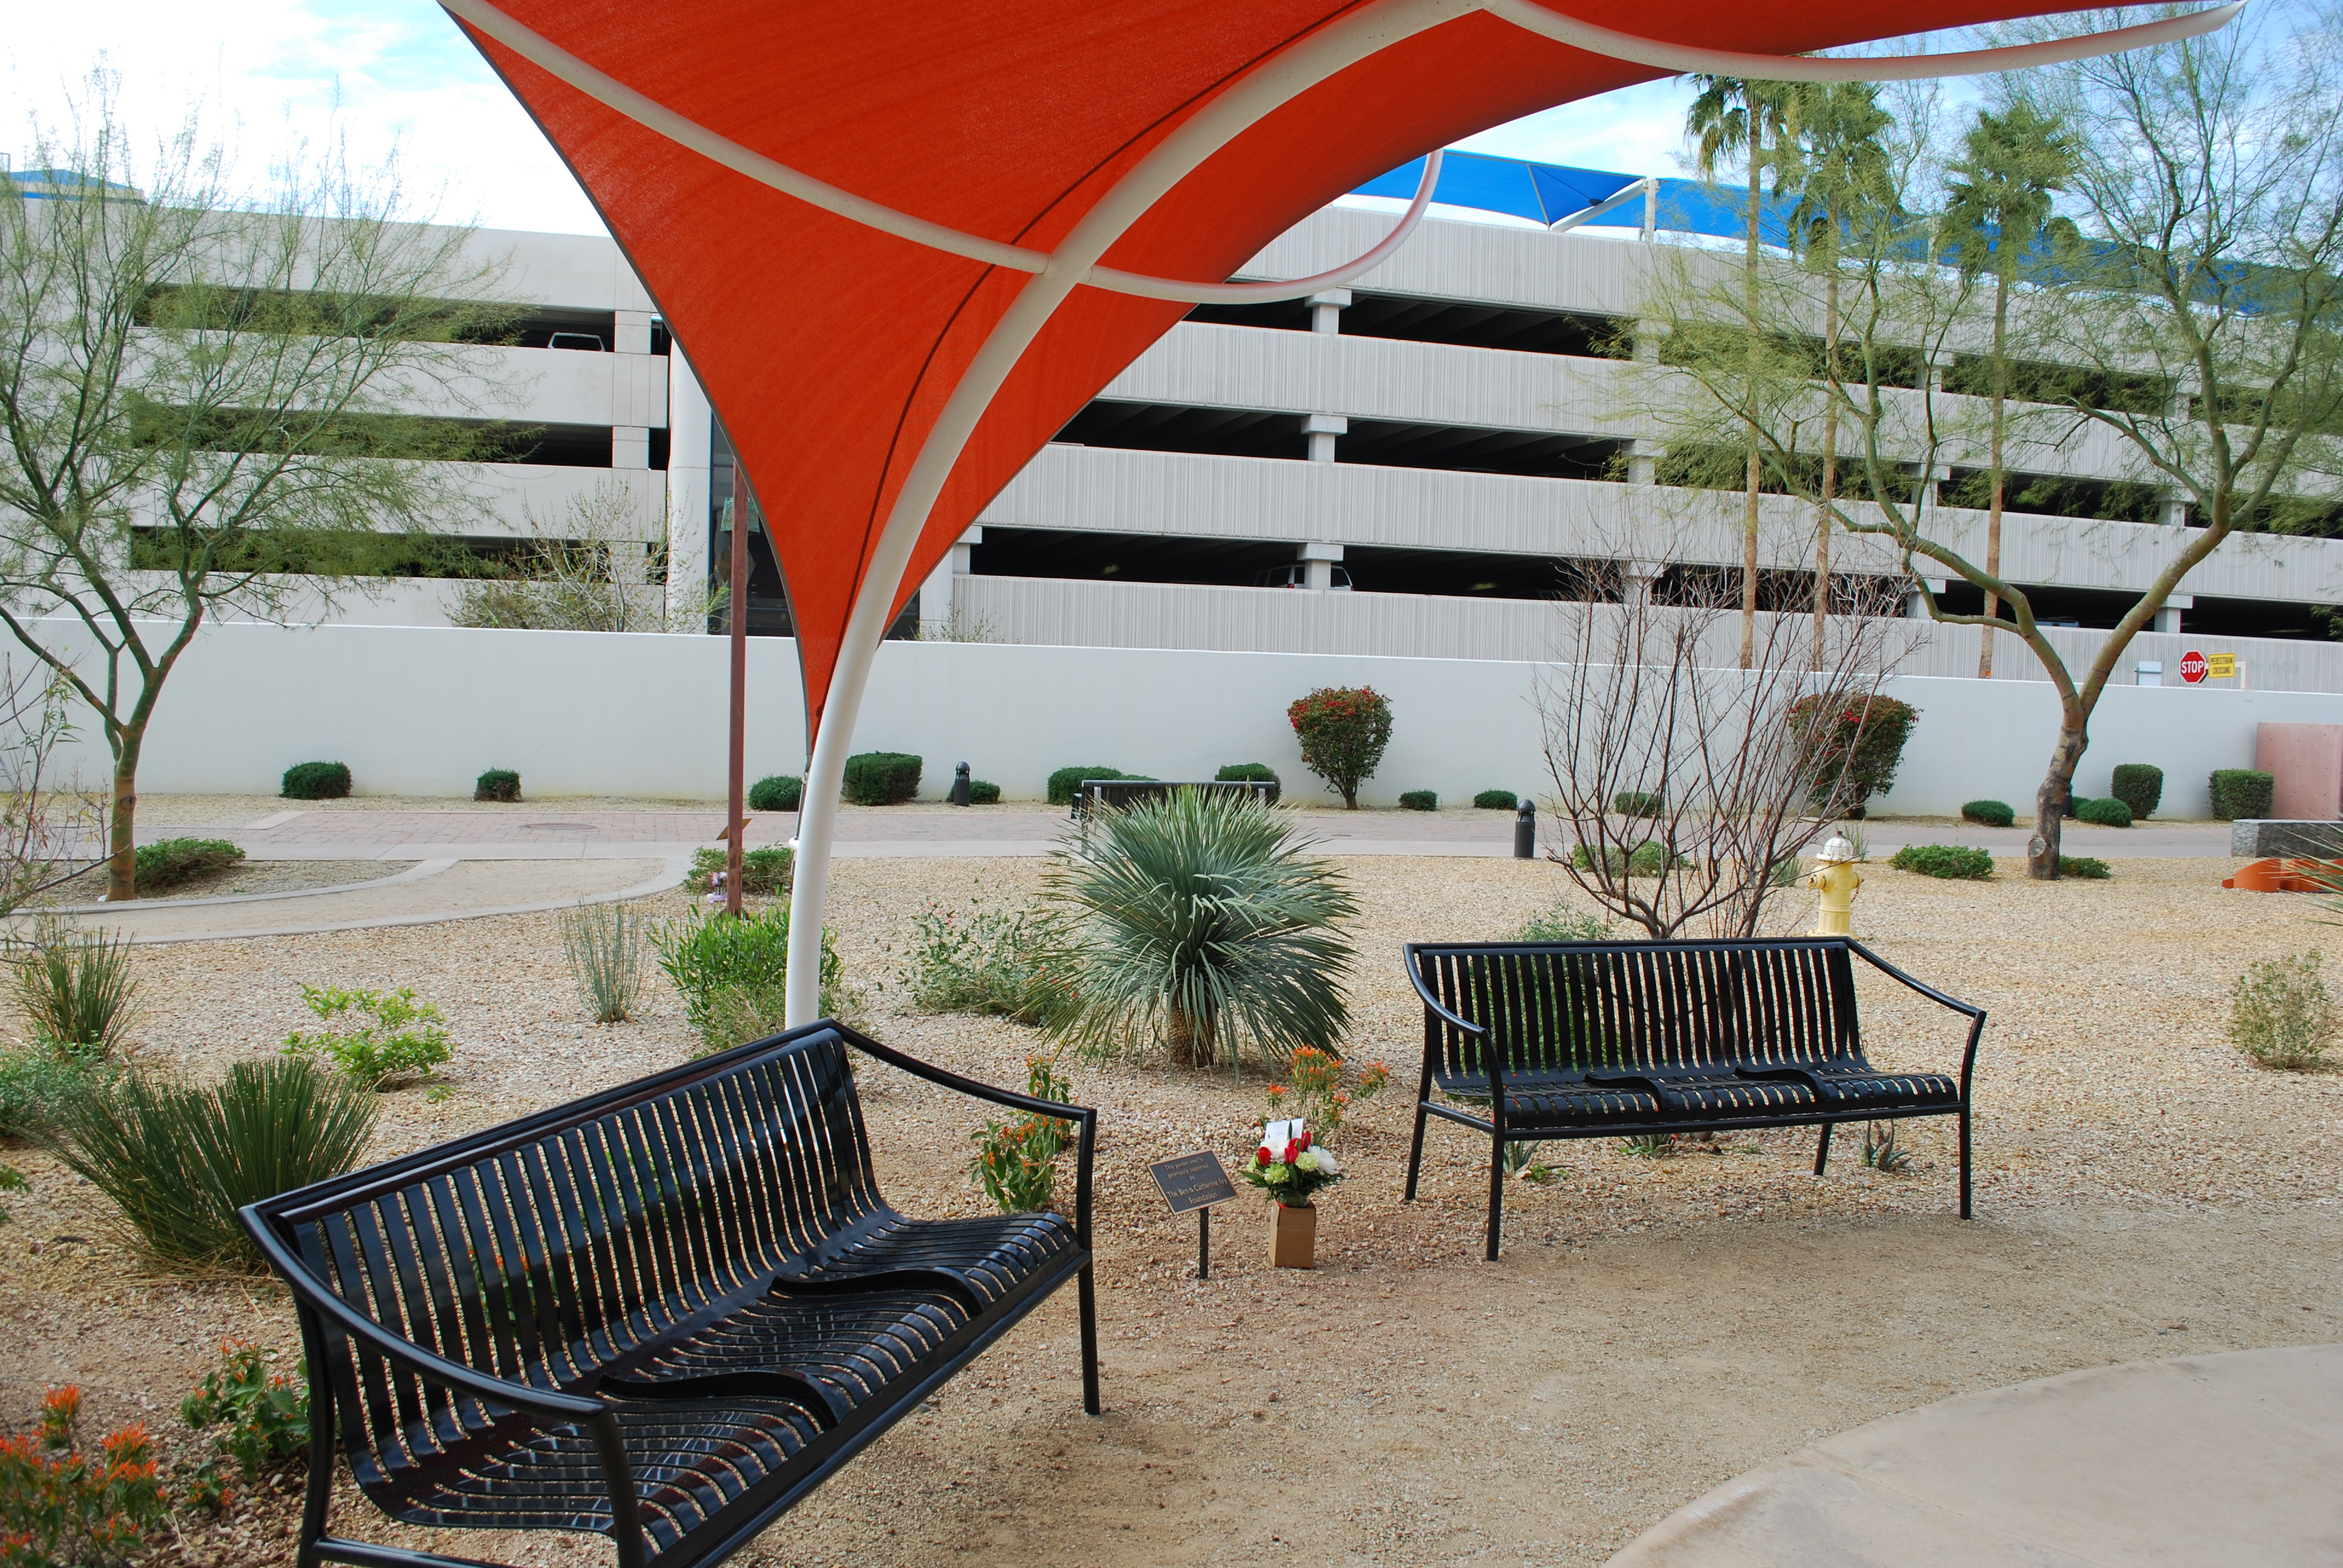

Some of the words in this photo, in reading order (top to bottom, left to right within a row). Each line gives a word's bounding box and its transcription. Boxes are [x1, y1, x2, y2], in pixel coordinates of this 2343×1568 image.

[2181, 661, 2204, 674] STOP
[2212, 666, 2230, 675] CROSSING
[1178, 1187, 1190, 1196] Ben
[1193, 1181, 1219, 1192] Catherine
[1188, 1192, 1218, 1204] Foundation
